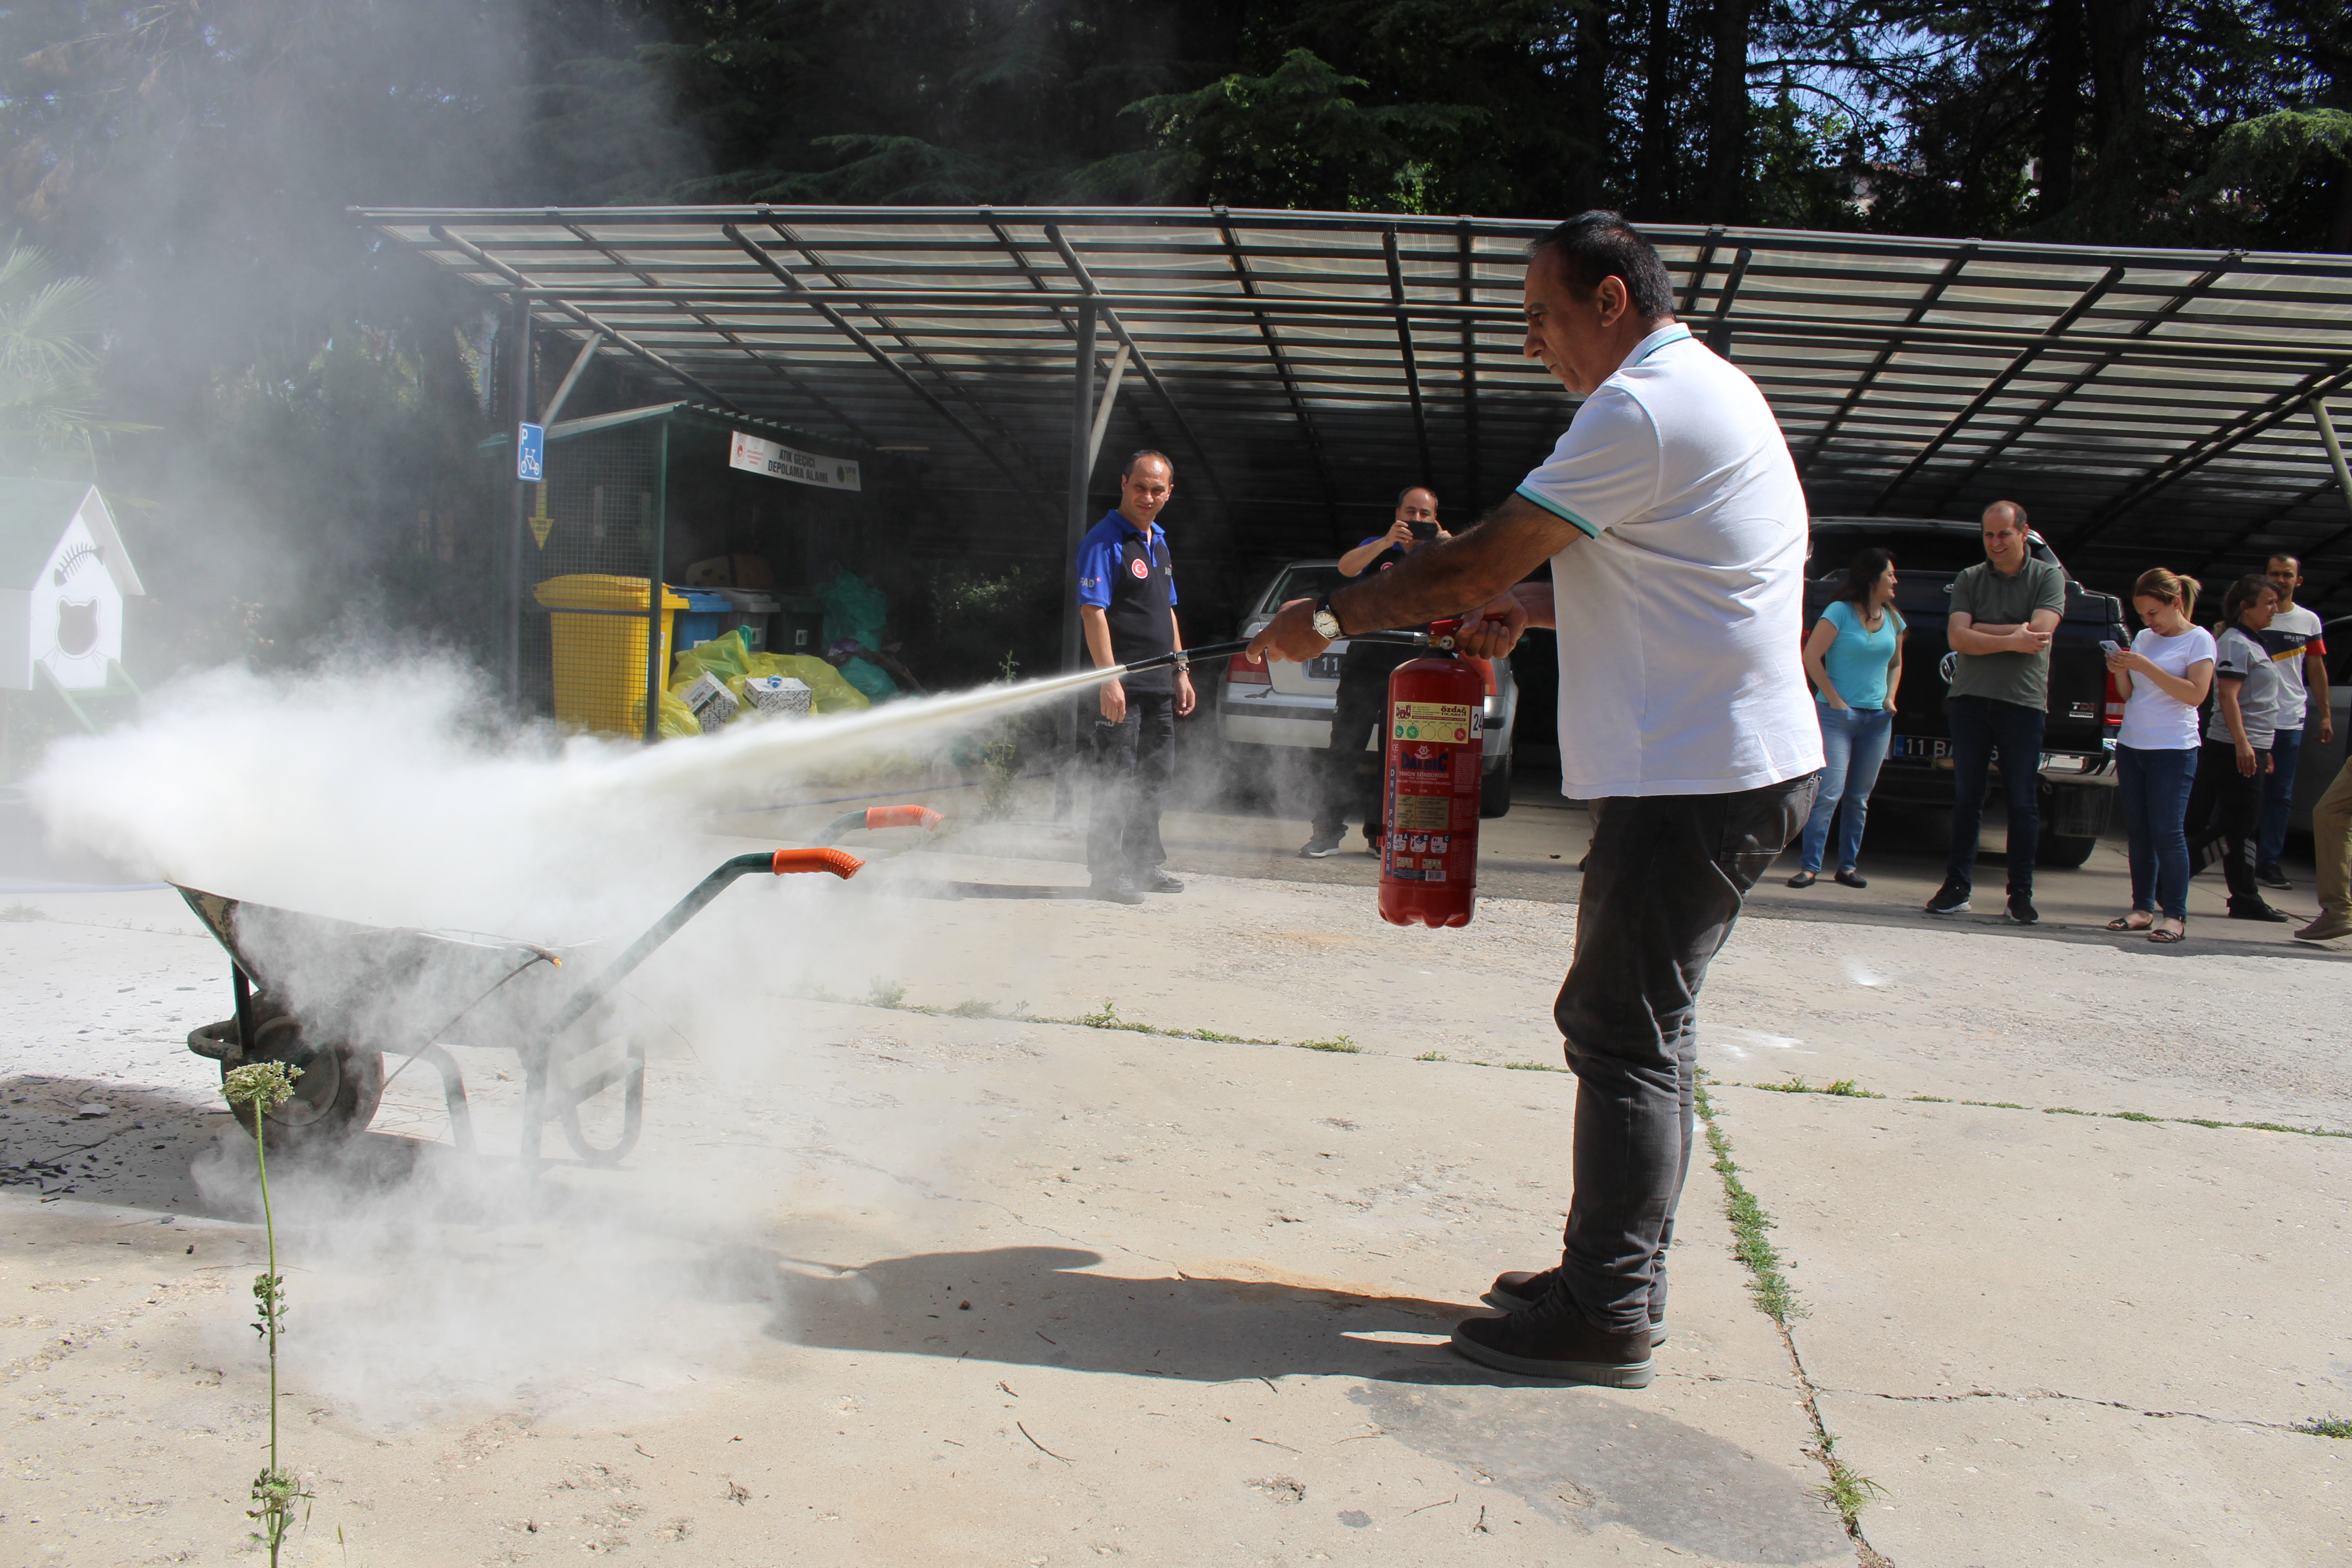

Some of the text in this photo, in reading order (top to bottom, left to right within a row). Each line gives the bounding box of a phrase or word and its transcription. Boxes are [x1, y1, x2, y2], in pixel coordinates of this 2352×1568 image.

[522, 428, 528, 445] P
[779, 449, 793, 463] ATIK
[794, 453, 815, 468] GEÇİCİ
[768, 460, 828, 483] DEPOLAMA ALANI
[1322, 657, 1338, 671] 11
[1473, 713, 1482, 731] 24
[1906, 739, 1924, 755] 11
